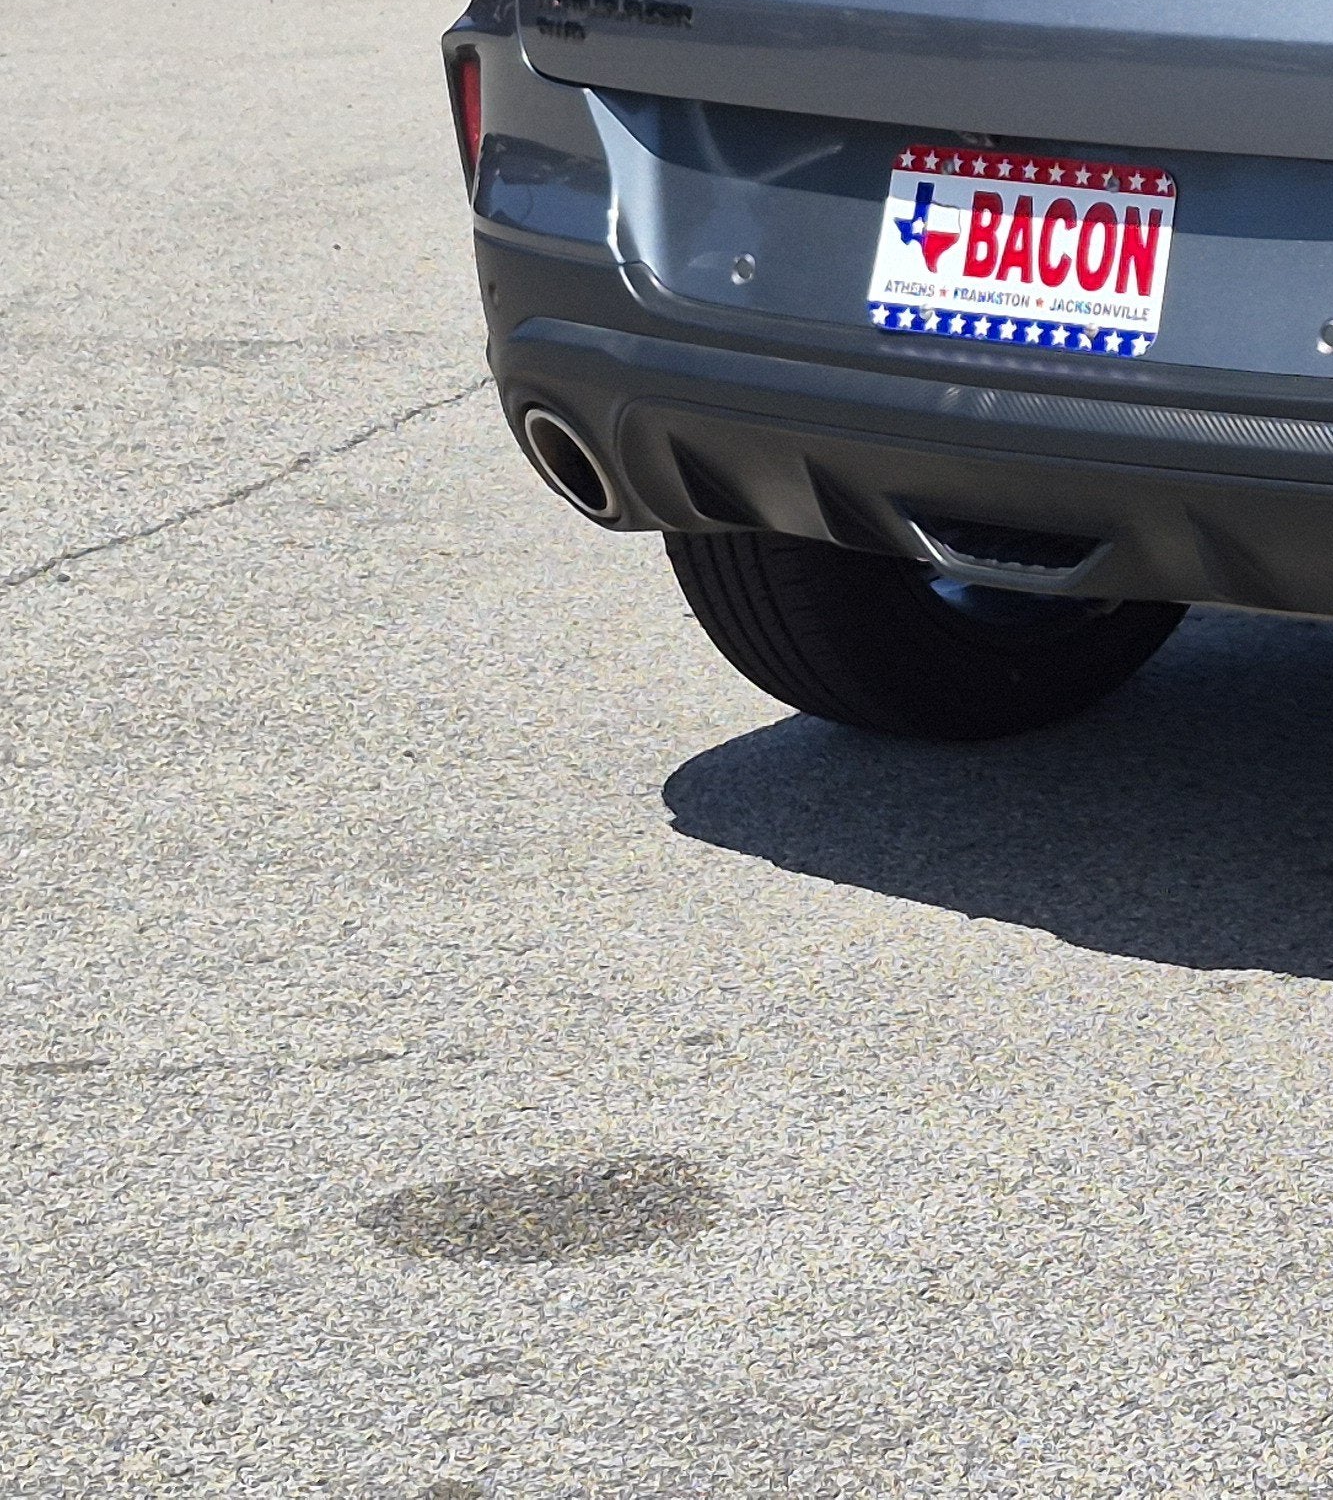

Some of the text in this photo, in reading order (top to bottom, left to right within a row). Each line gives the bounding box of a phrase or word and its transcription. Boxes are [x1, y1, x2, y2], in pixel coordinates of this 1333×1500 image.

[962, 190, 1163, 296] BACON
[883, 280, 1150, 322] ATHENS FRANKSTON JACKSONVILLE
